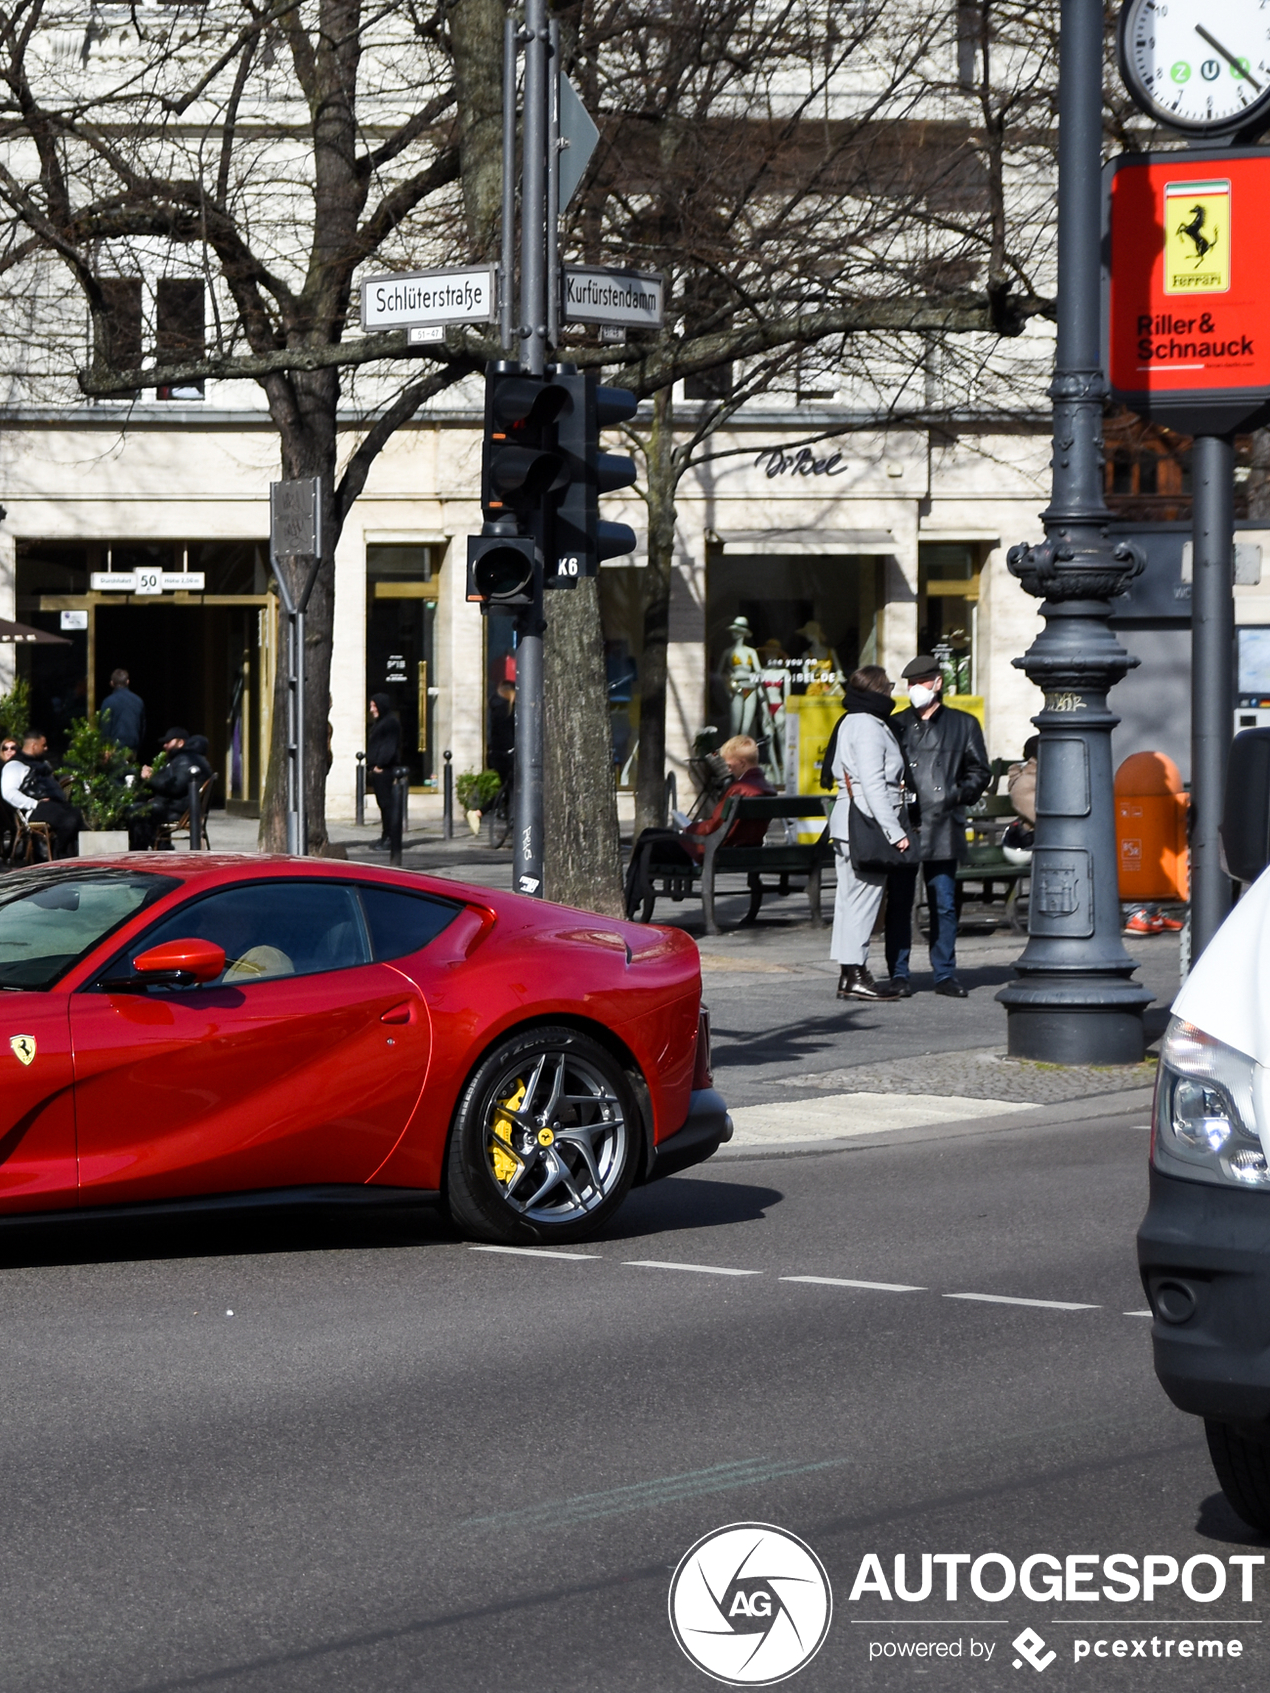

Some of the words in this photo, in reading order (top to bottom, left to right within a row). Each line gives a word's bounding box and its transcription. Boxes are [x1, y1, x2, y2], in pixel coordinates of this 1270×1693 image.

[376, 280, 482, 313] Schlüterstraße
[567, 277, 657, 311] Kurfürstendamm
[1137, 335, 1255, 361] Schnauck
[557, 557, 578, 576] K6
[140, 574, 157, 588] 50
[785, 659, 803, 668] you
